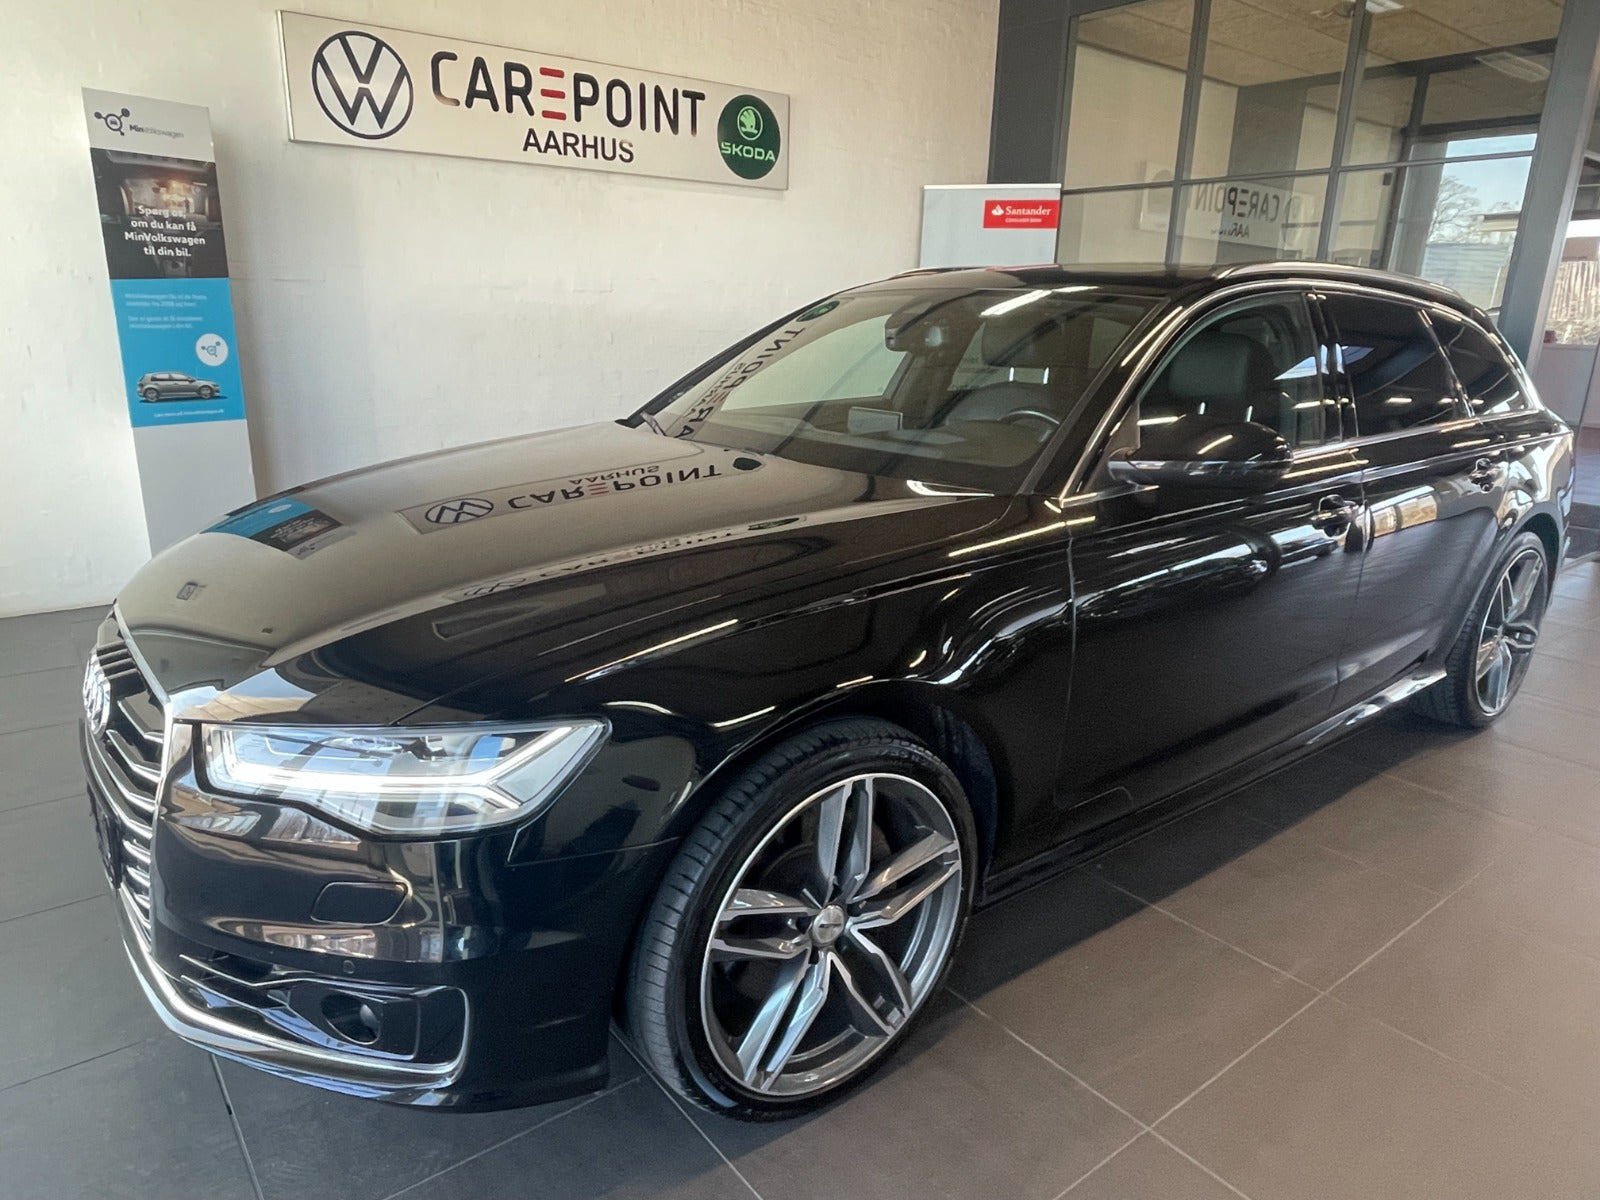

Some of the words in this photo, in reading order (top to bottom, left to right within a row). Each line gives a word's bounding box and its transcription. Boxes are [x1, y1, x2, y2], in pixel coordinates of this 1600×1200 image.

[431, 51, 706, 137] CAREPOINT
[522, 127, 634, 163] AARHUS
[1005, 205, 1052, 216] Santander
[130, 220, 148, 228] om
[150, 220, 164, 229] du
[165, 221, 185, 230] kan
[186, 221, 197, 231] få
[124, 231, 206, 246] MinVolkswagen
[143, 246, 156, 256] til
[157, 246, 174, 256] din
[175, 247, 192, 257] bil.
